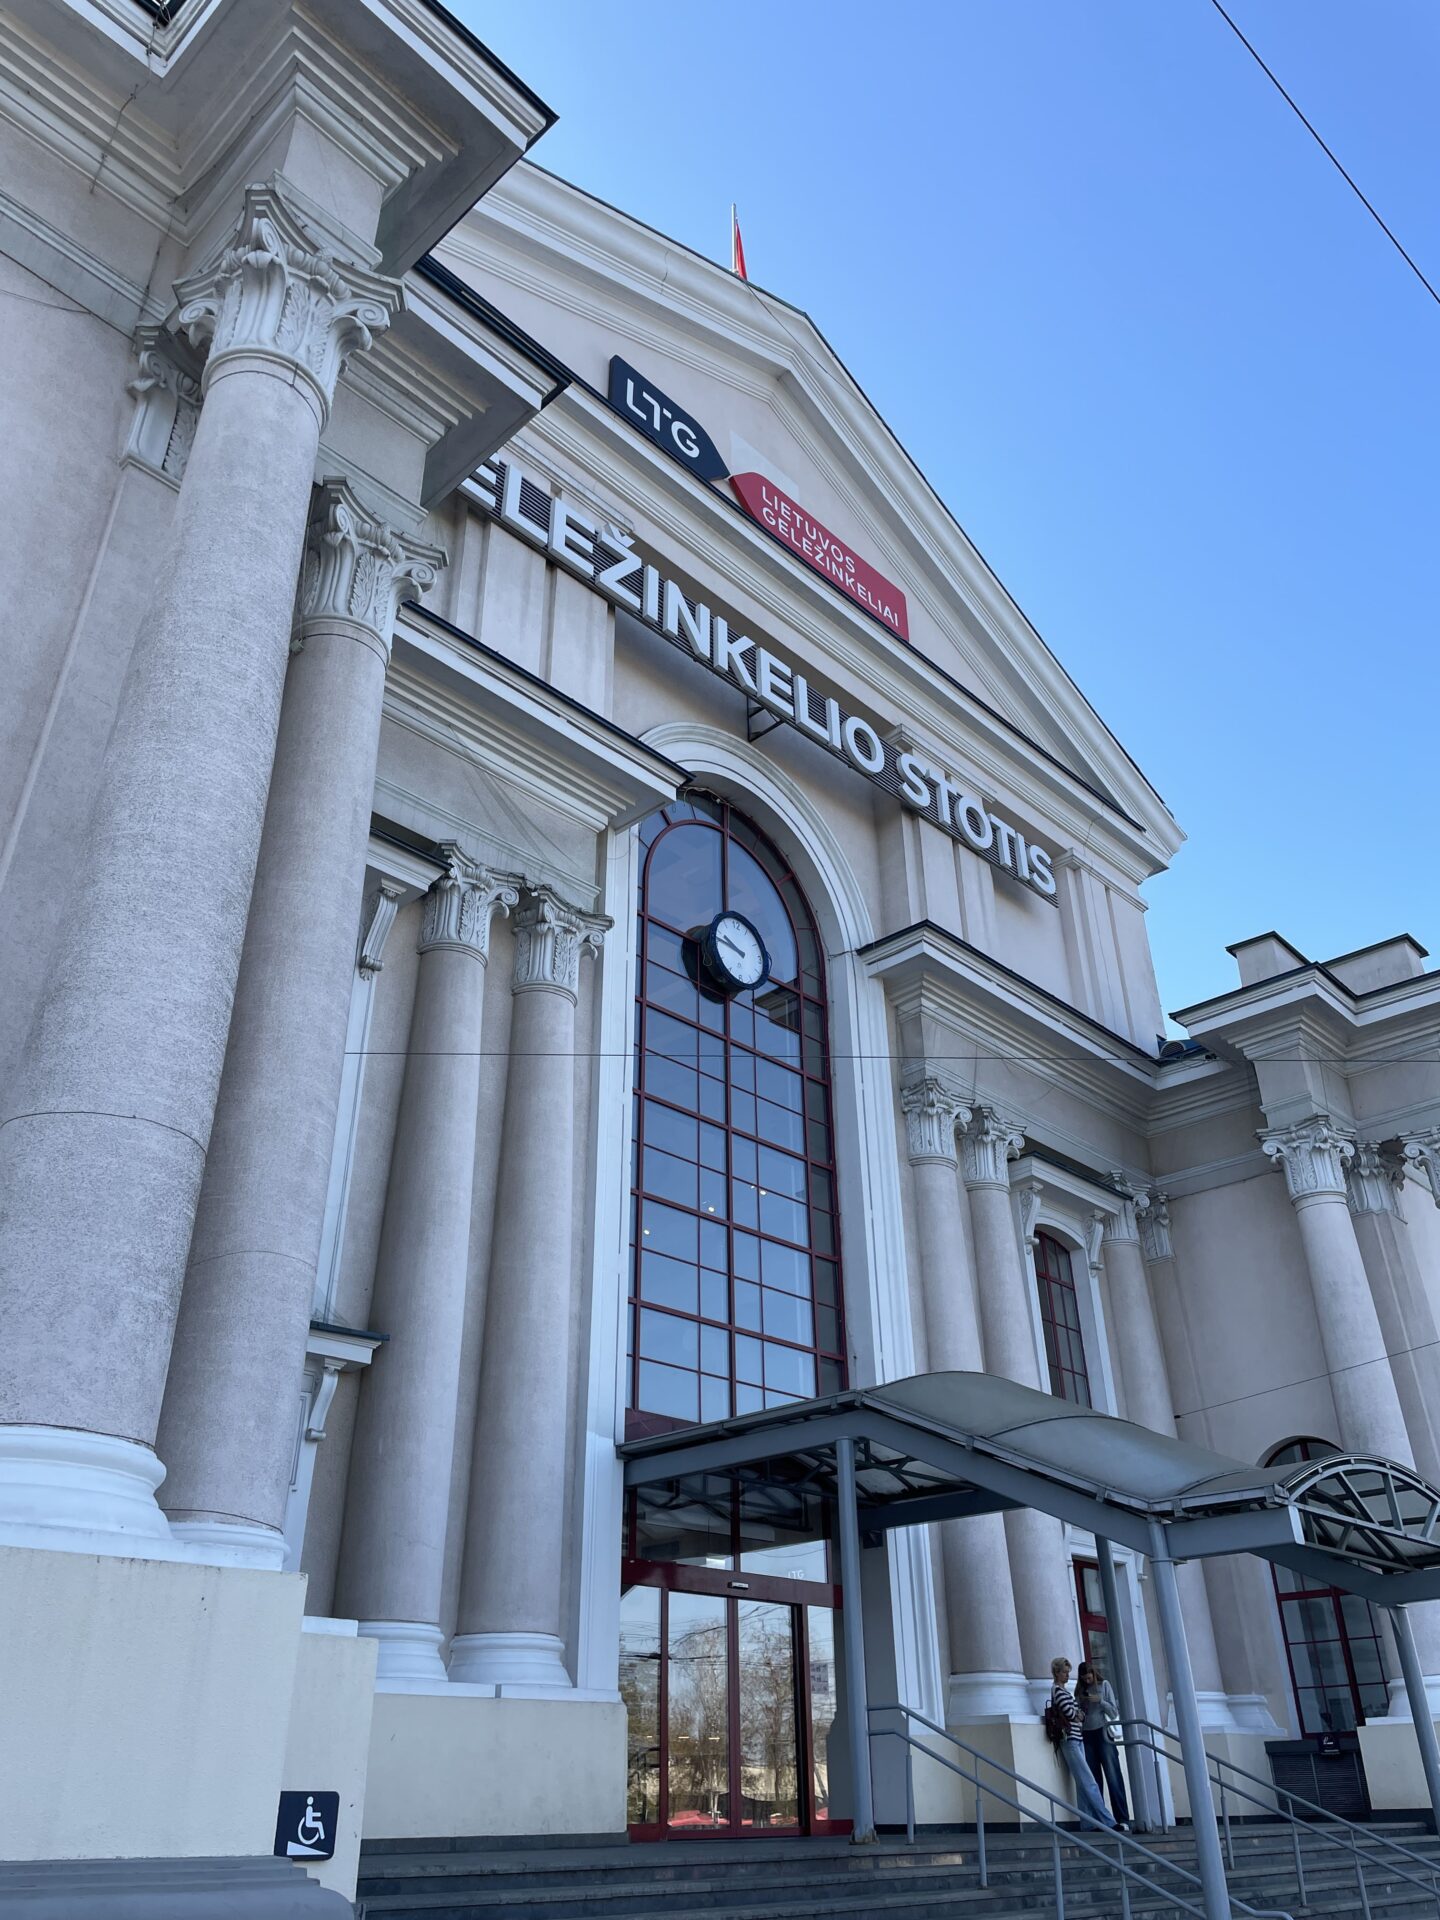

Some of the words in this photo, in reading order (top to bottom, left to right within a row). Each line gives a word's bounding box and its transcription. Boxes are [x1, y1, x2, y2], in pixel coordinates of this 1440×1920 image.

[627, 378, 700, 458] LTG
[762, 486, 856, 574] LIETUVOS
[762, 507, 899, 627] GELEŽINKELIAI
[897, 752, 1057, 896] STOTIS
[732, 920, 741, 931] 12
